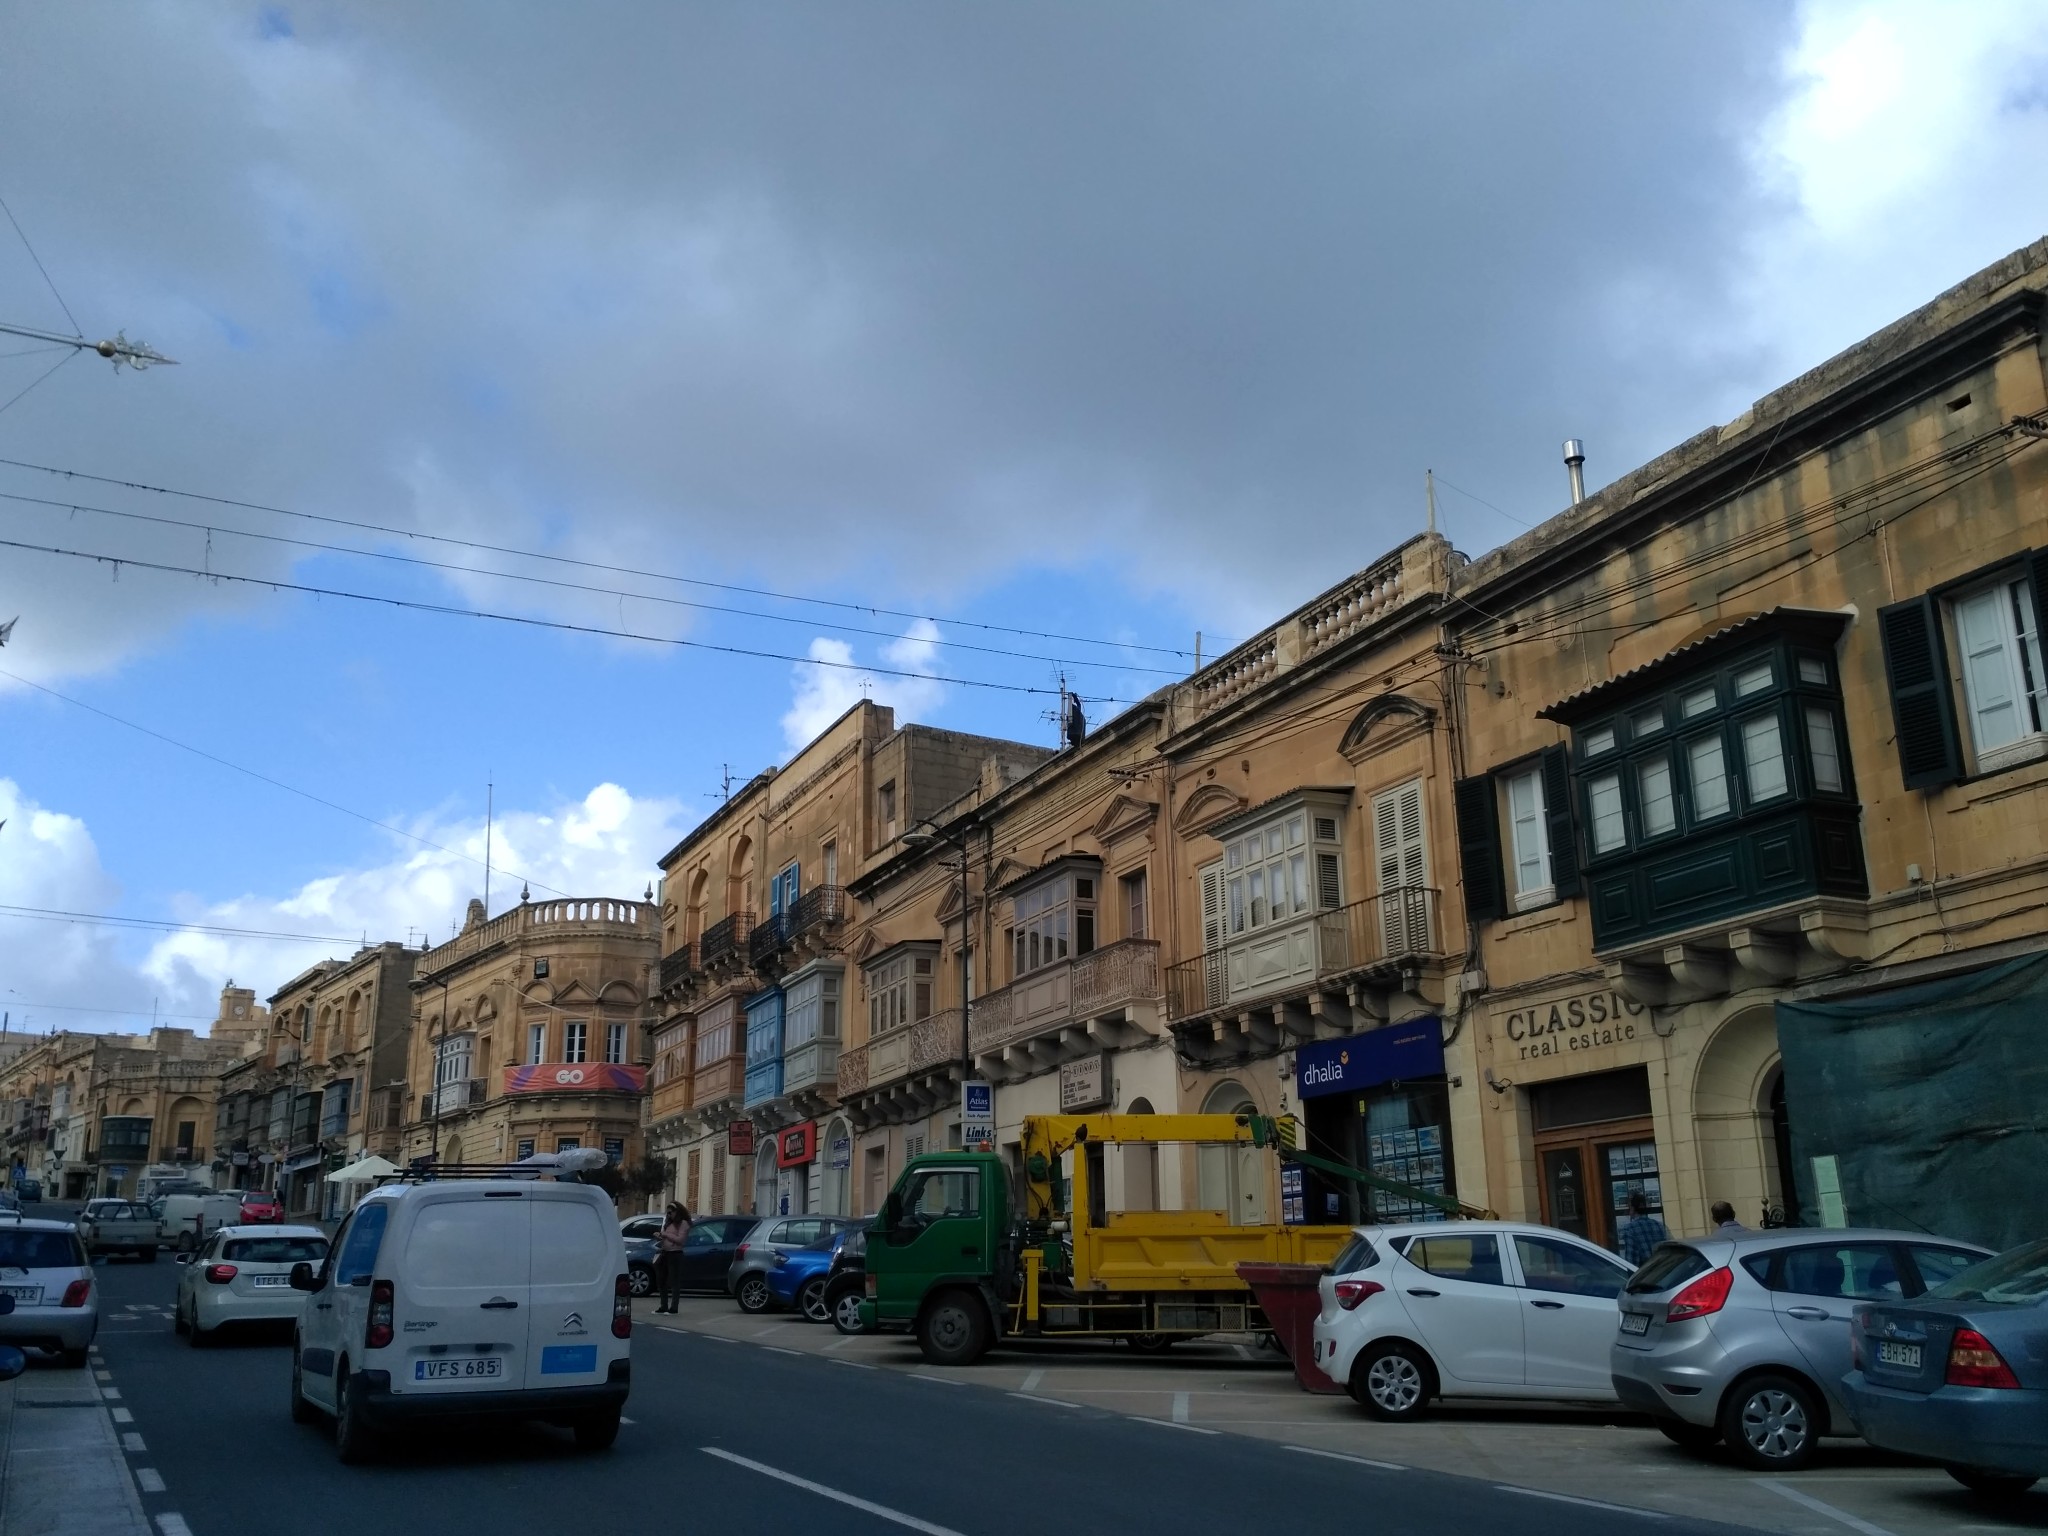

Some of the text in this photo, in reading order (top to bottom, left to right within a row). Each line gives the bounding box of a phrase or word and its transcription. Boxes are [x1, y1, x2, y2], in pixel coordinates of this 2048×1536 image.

[1520, 1023, 1635, 1060] real estate
[556, 1069, 584, 1084] GO
[1304, 1060, 1344, 1085] dhalia
[969, 1097, 989, 1105] Atlas
[966, 1126, 992, 1137] Links
[14, 1289, 35, 1298] 112
[1881, 1342, 1919, 1365] EBH 571
[427, 1360, 496, 1377] VFS 685
